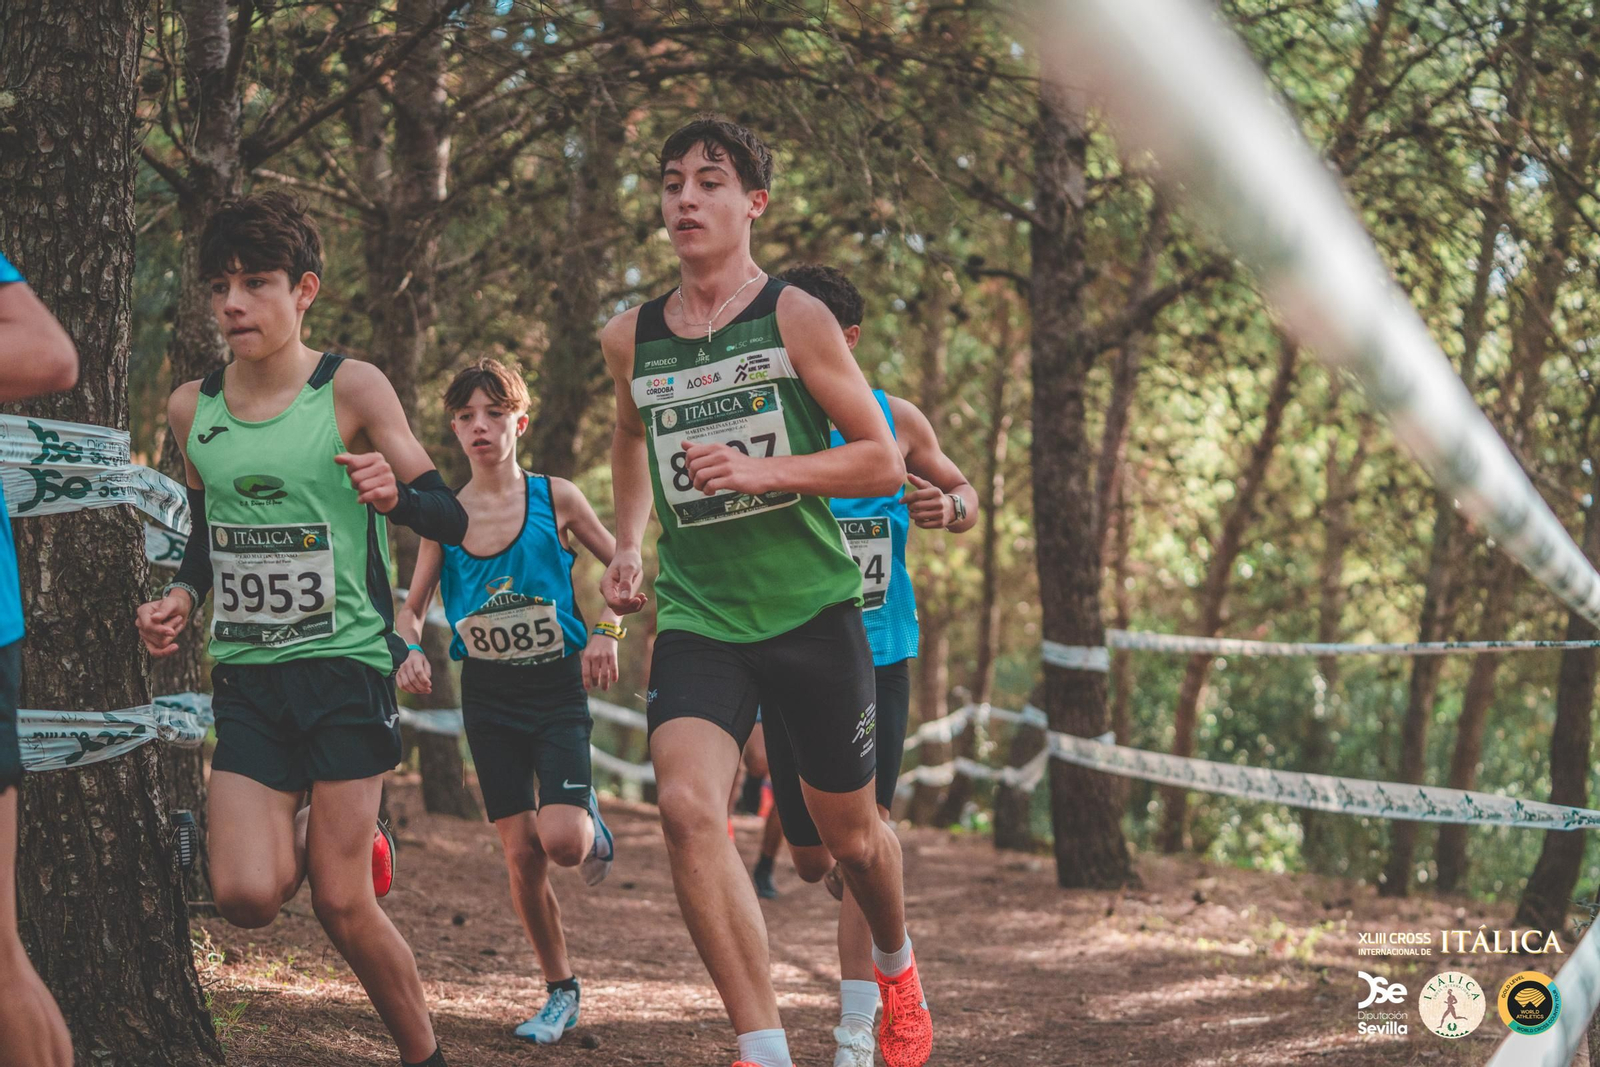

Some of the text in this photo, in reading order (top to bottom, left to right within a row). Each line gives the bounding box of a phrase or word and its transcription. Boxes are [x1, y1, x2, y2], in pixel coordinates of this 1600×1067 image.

[650, 356, 678, 368] IMDECO
[684, 397, 744, 421] ITÁLICA
[233, 529, 294, 545] ITÁLICA
[221, 571, 325, 614] 5953
[469, 617, 556, 653] 8085
